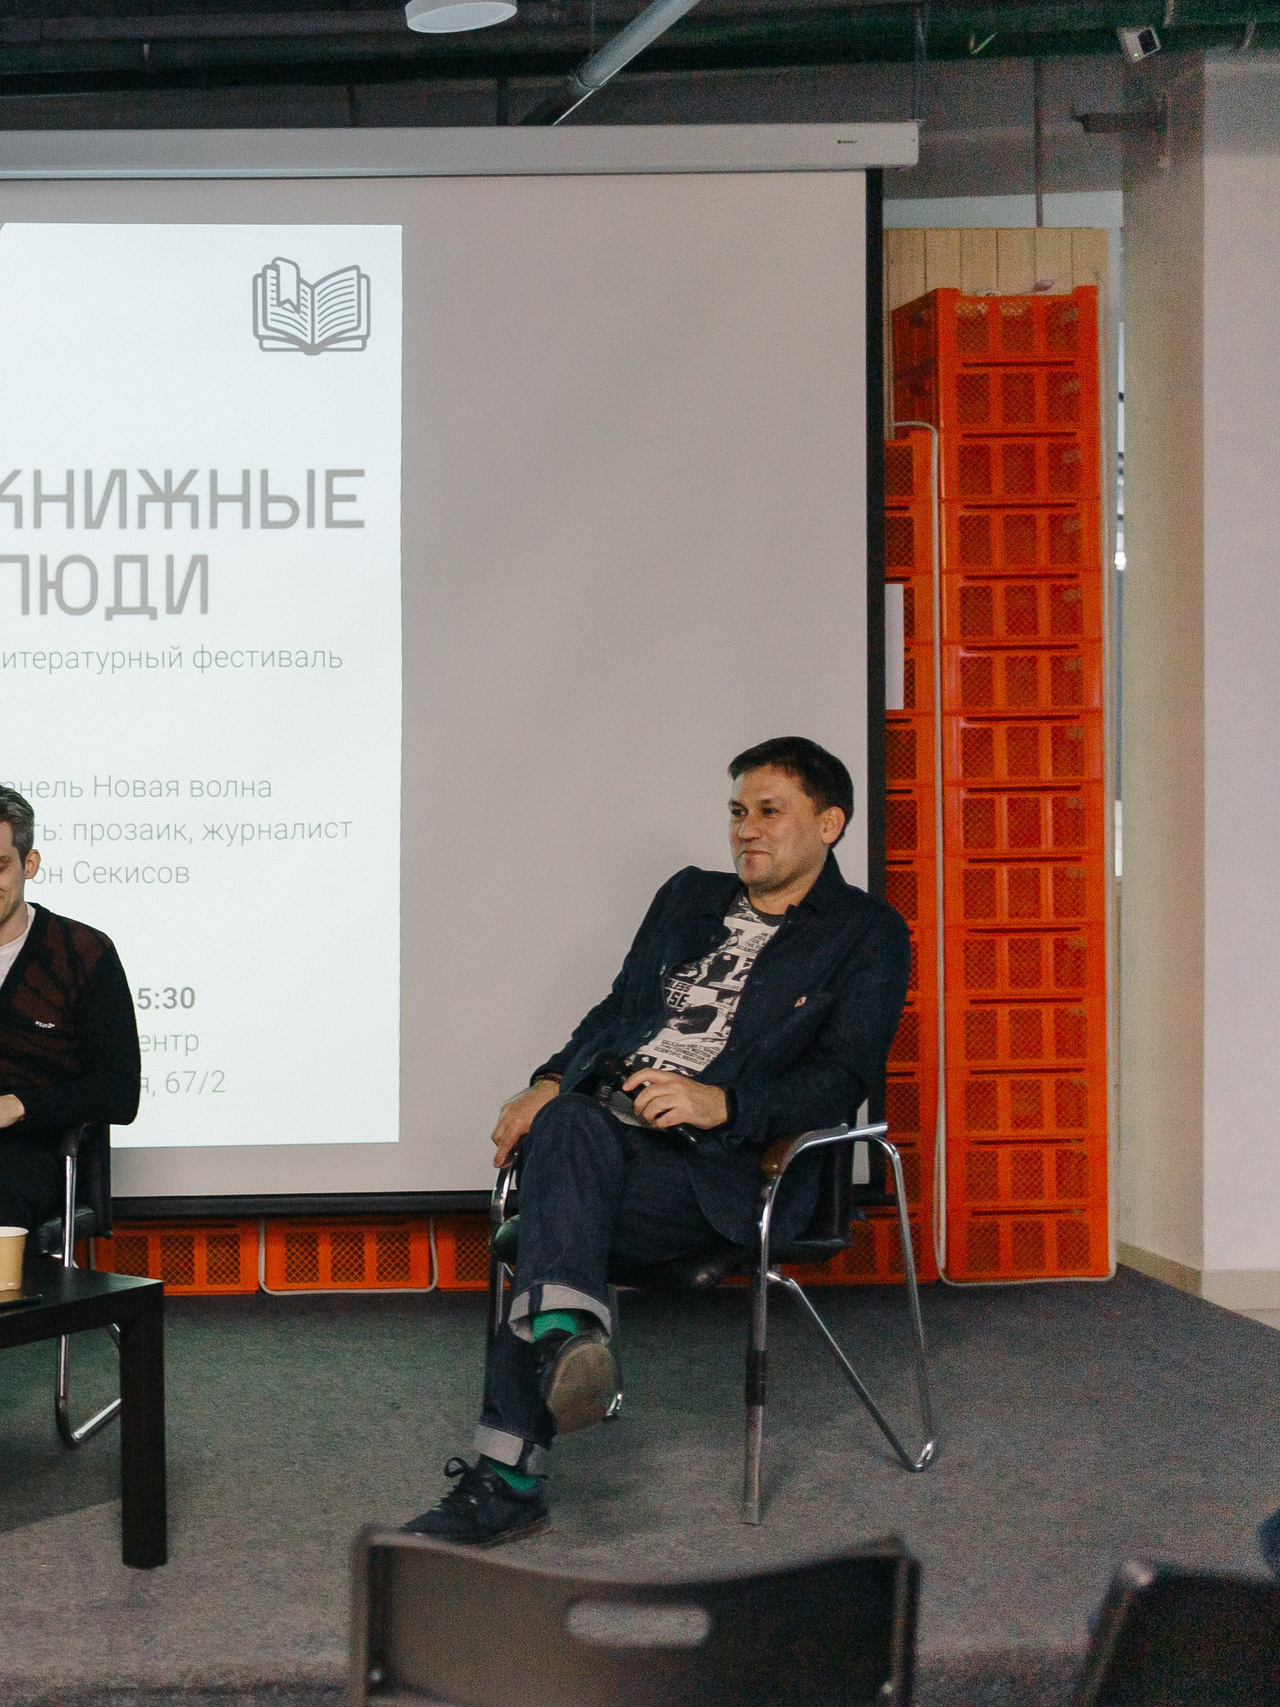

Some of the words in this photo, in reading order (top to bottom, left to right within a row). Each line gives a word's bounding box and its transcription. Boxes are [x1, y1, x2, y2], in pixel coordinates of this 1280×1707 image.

[192, 645, 343, 674] фестиваль
[94, 775, 180, 798] Новая
[190, 780, 272, 798] волна
[73, 822, 193, 847] прозаик,
[202, 821, 353, 848] журналист
[32, 867, 63, 884] он
[73, 861, 190, 885] Секисов
[136, 986, 196, 1010] 5:30
[139, 1034, 200, 1057] ентр
[165, 1070, 226, 1095] 67/2
